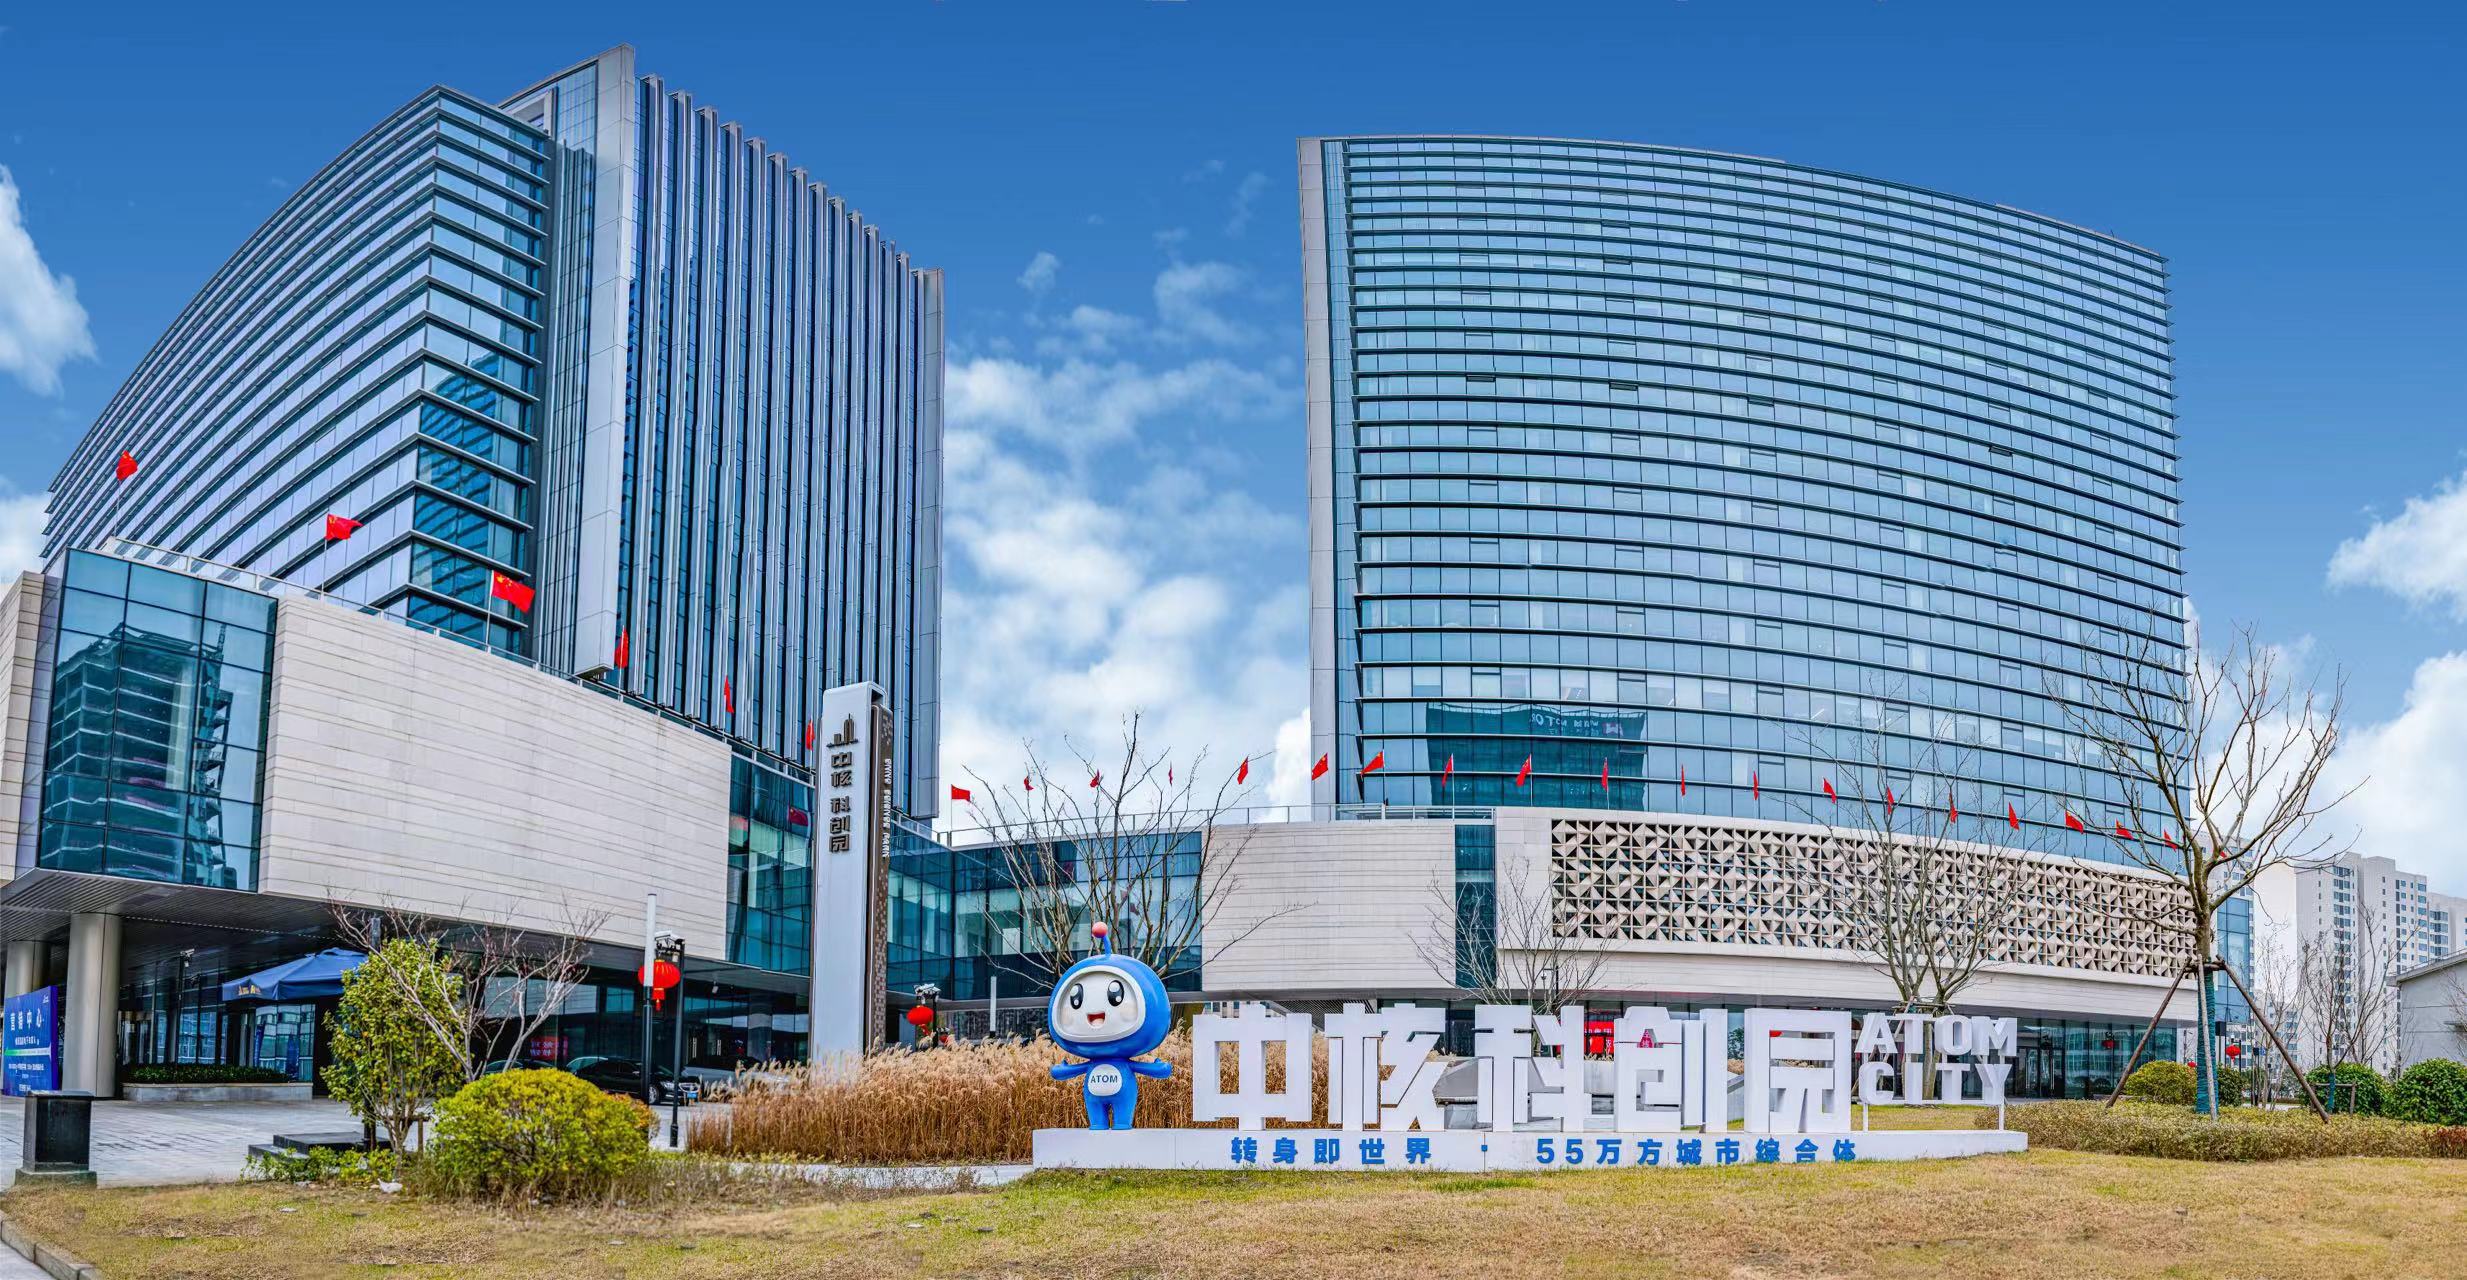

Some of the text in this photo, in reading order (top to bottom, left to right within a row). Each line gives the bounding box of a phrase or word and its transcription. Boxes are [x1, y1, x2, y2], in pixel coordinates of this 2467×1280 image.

[1855, 1012, 2017, 1056] ATOM
[1091, 1075, 1118, 1083] ATOM
[1192, 1003, 1851, 1133] 中核科创园
[1858, 1062, 2012, 1105] CITY
[1231, 1136, 1432, 1165] 转身即世界
